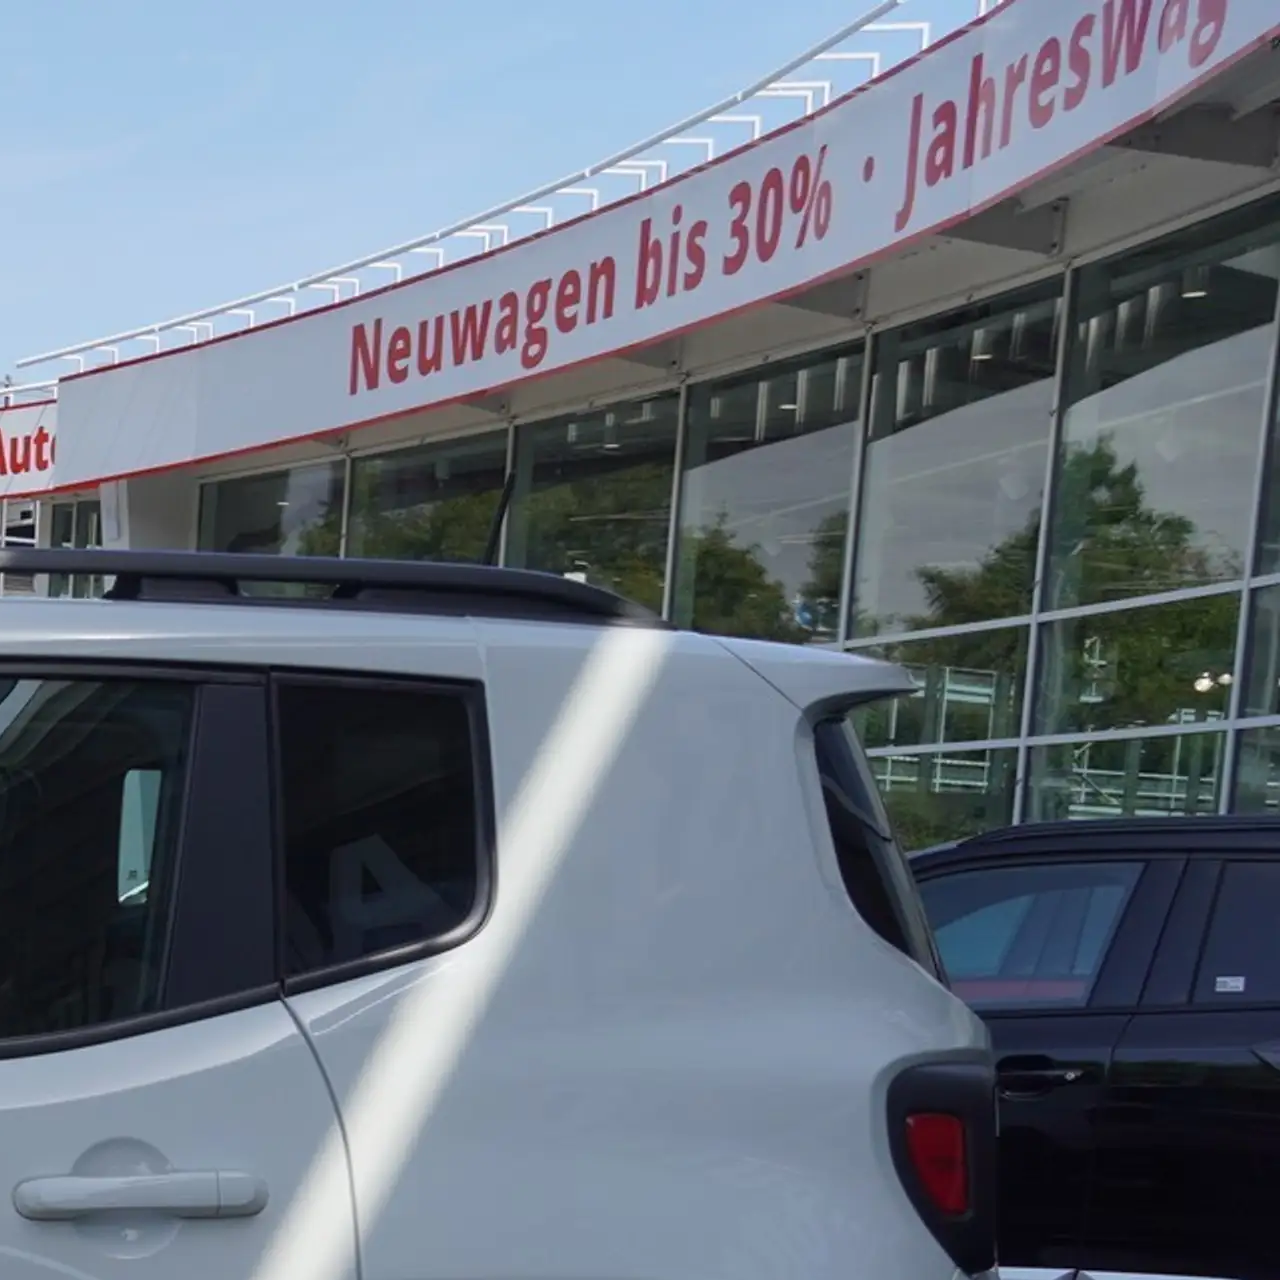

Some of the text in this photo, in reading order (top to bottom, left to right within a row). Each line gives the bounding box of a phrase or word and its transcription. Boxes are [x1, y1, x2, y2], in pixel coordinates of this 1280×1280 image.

[349, 255, 616, 396] Neuwagen
[634, 204, 708, 310] bis
[722, 143, 833, 276] 30%
